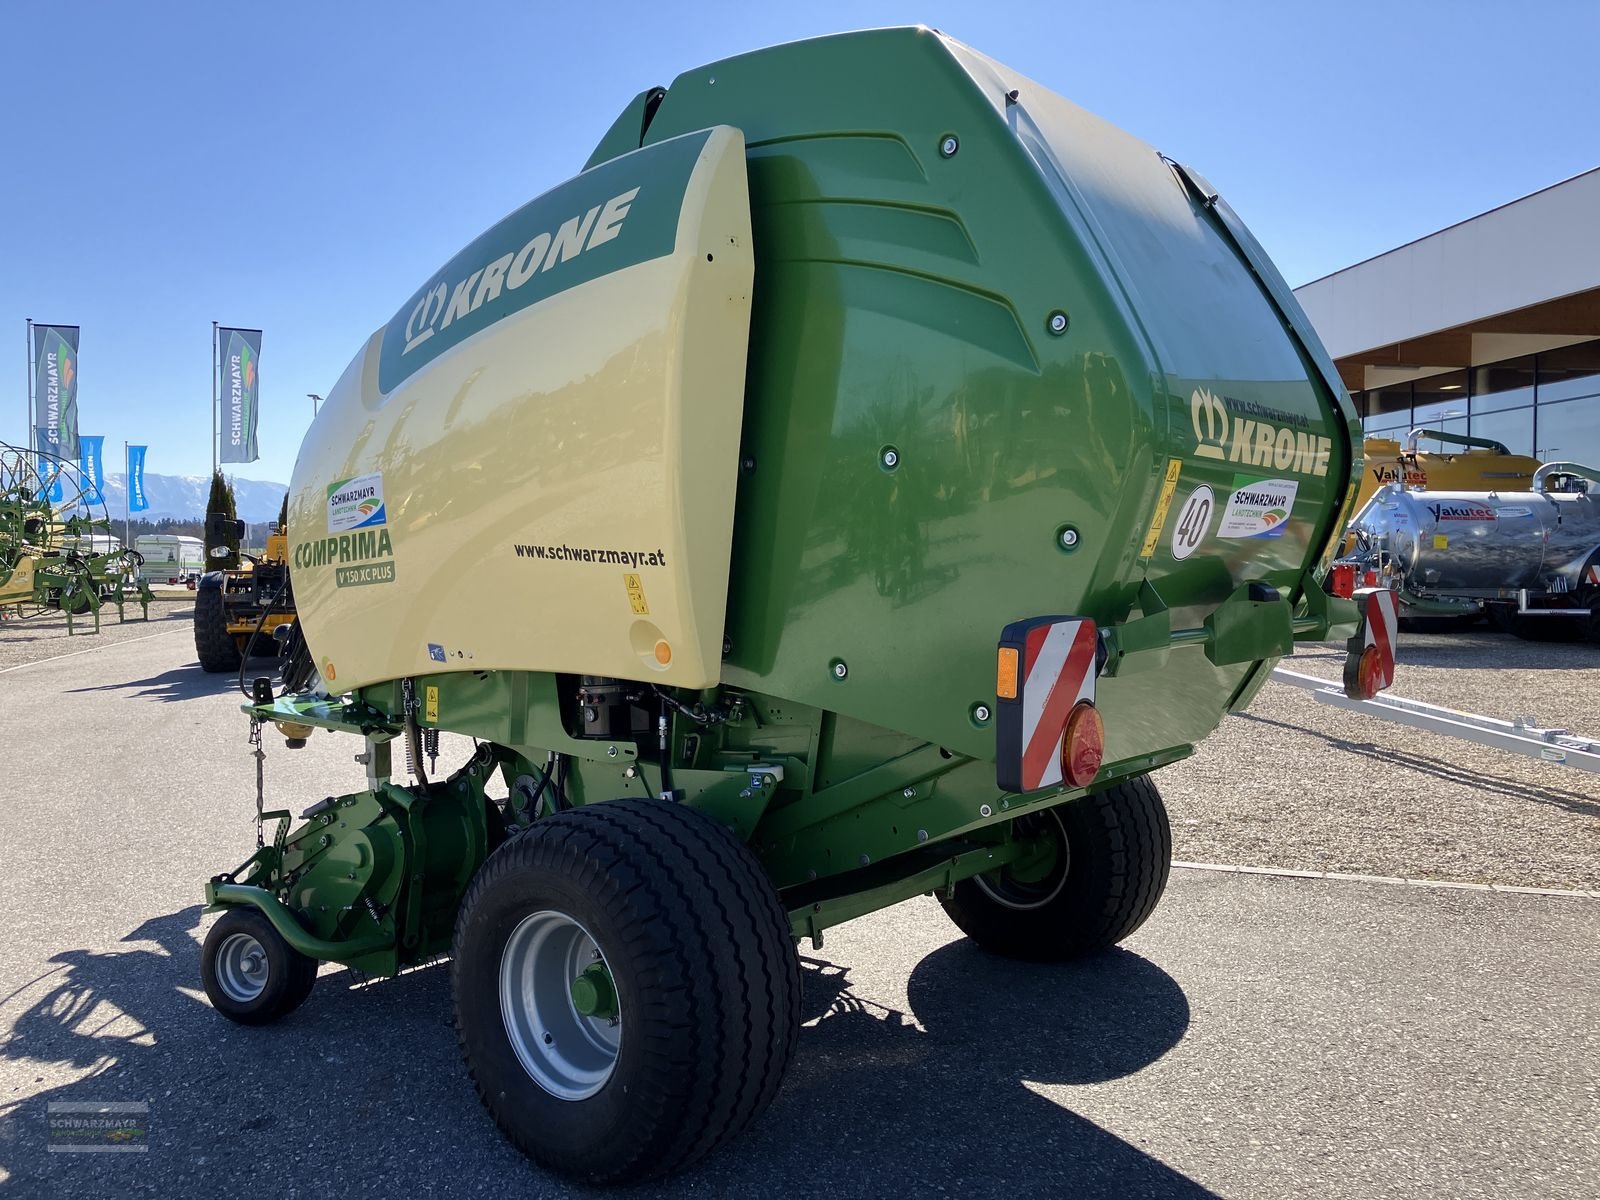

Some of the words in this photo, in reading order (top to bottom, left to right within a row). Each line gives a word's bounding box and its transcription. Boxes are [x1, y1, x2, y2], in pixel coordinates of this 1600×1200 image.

[440, 186, 641, 331] KRONE
[47, 352, 59, 445] SCHWARZMAYR
[231, 355, 242, 446] SCHWARZMAYR
[1223, 396, 1310, 429] www.schwarzmayr.at
[1229, 417, 1332, 477] KRONE
[331, 486, 375, 506] SCHWARZMAYR
[1234, 491, 1287, 507] SCHWARZMAYR
[1427, 503, 1494, 523] Vakutec
[1177, 498, 1210, 547] 40
[295, 528, 393, 570] COMPRIMA
[514, 544, 666, 568] www.schwarzmayr.at
[339, 572, 345, 584] V
[346, 571, 359, 583] 150
[360, 568, 371, 581] XC
[372, 566, 392, 579] PLUS
